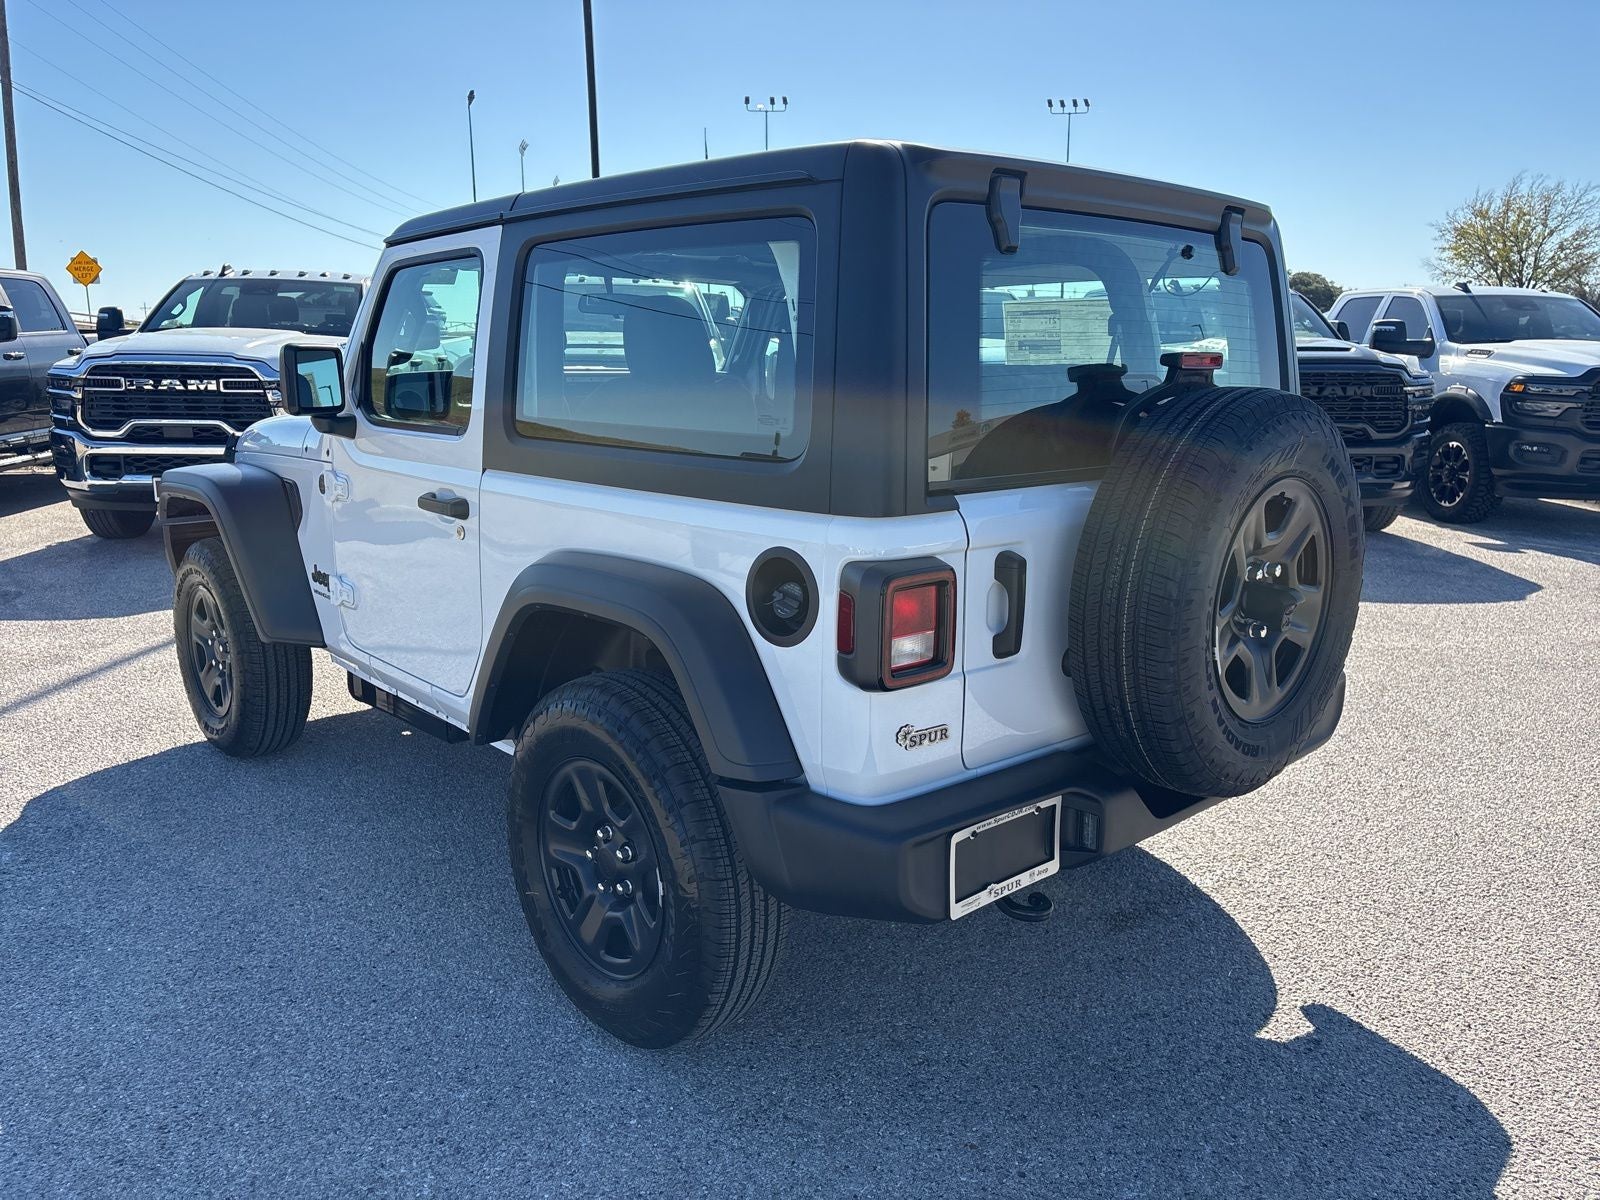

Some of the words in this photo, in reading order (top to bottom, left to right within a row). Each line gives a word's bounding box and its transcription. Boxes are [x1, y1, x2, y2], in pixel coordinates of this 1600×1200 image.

[126, 379, 217, 390] RAM
[1301, 385, 1372, 397] RAM
[1209, 697, 1260, 758] ROADIAN
[909, 728, 949, 748] SPUR
[993, 879, 1022, 898] SPUR
[1036, 867, 1049, 877] Jeep
